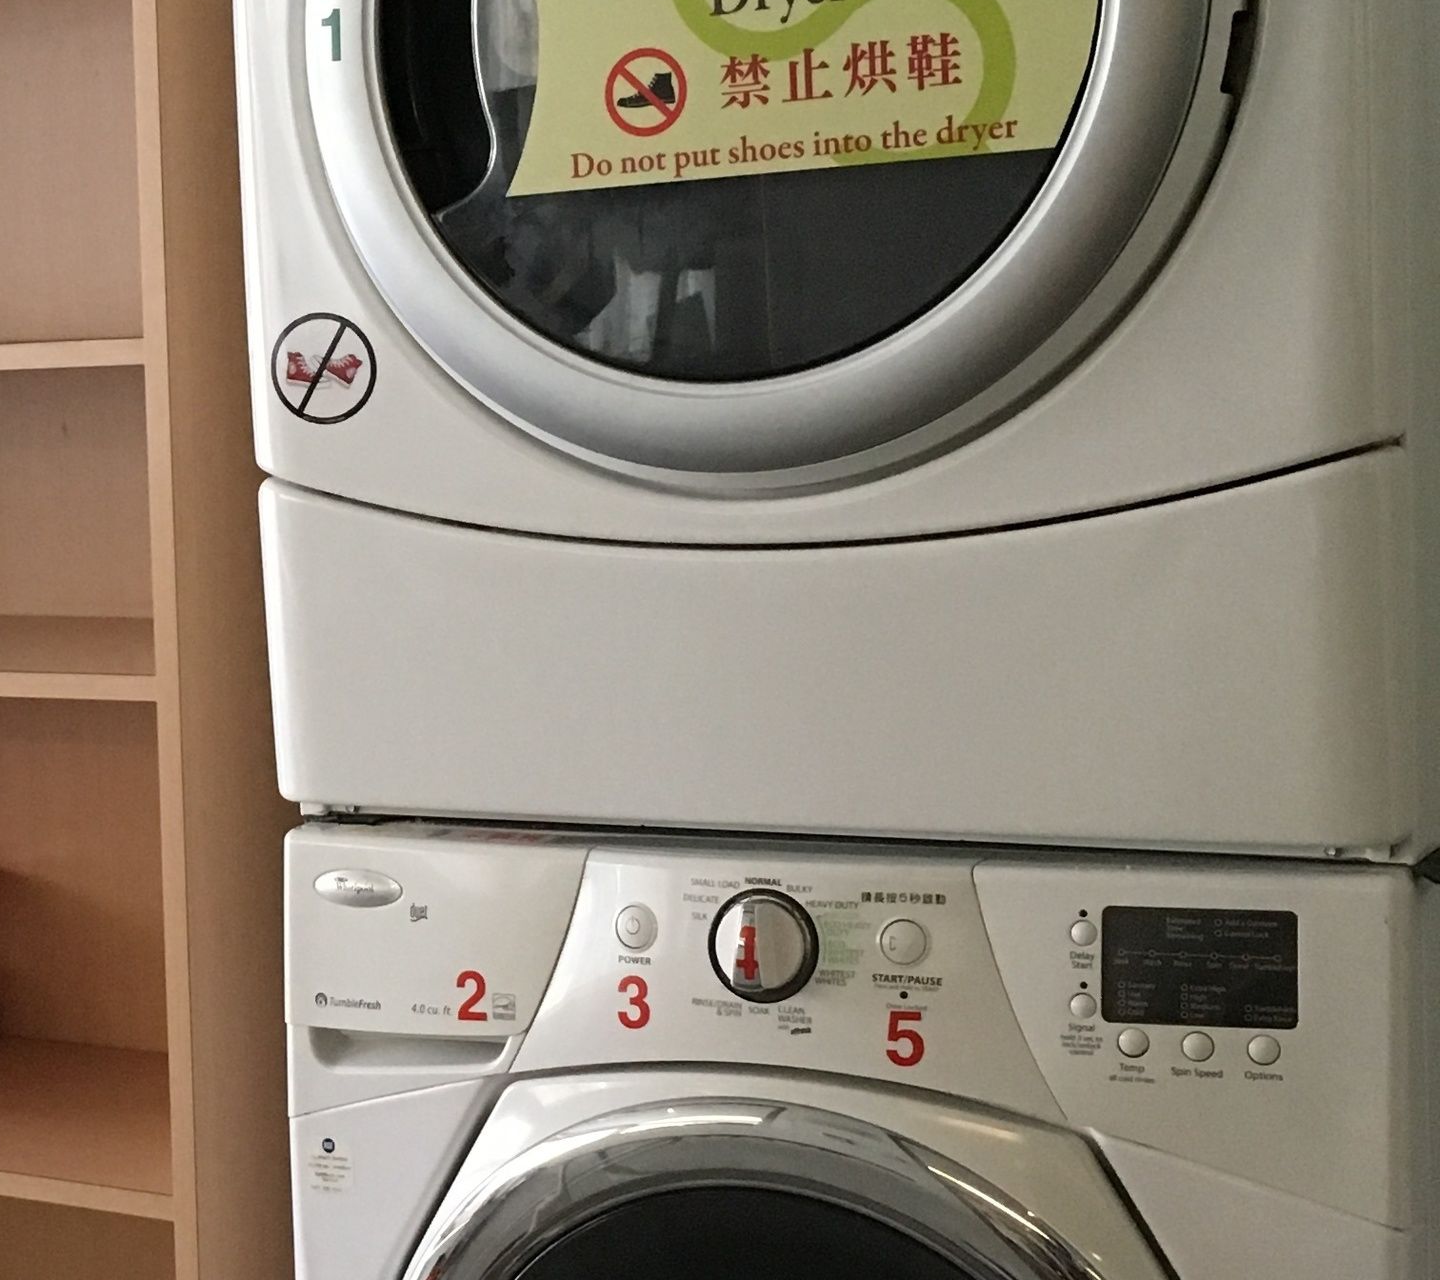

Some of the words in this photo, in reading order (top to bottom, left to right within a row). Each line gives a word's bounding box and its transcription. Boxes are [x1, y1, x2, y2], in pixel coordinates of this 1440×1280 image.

[321, 8, 341, 61] 1
[720, 32, 963, 109] 禁止烘鞋
[570, 152, 613, 179] Do
[621, 150, 666, 175] not
[674, 147, 721, 179] put
[728, 135, 804, 165] shoes
[813, 130, 872, 157] into
[881, 121, 928, 150] the
[936, 115, 1018, 152] dryer
[744, 877, 782, 887] NORMAL
[618, 955, 651, 966] POWER
[456, 970, 488, 1021] 2
[872, 973, 943, 987] START/PAUSE
[330, 996, 381, 1011] TumbleFresh
[618, 975, 650, 1029] 3
[886, 1011, 925, 1067] 5
[1171, 1067, 1193, 1079] Spin
[1194, 1069, 1223, 1080] Speed
[1244, 1070, 1284, 1083] Options
